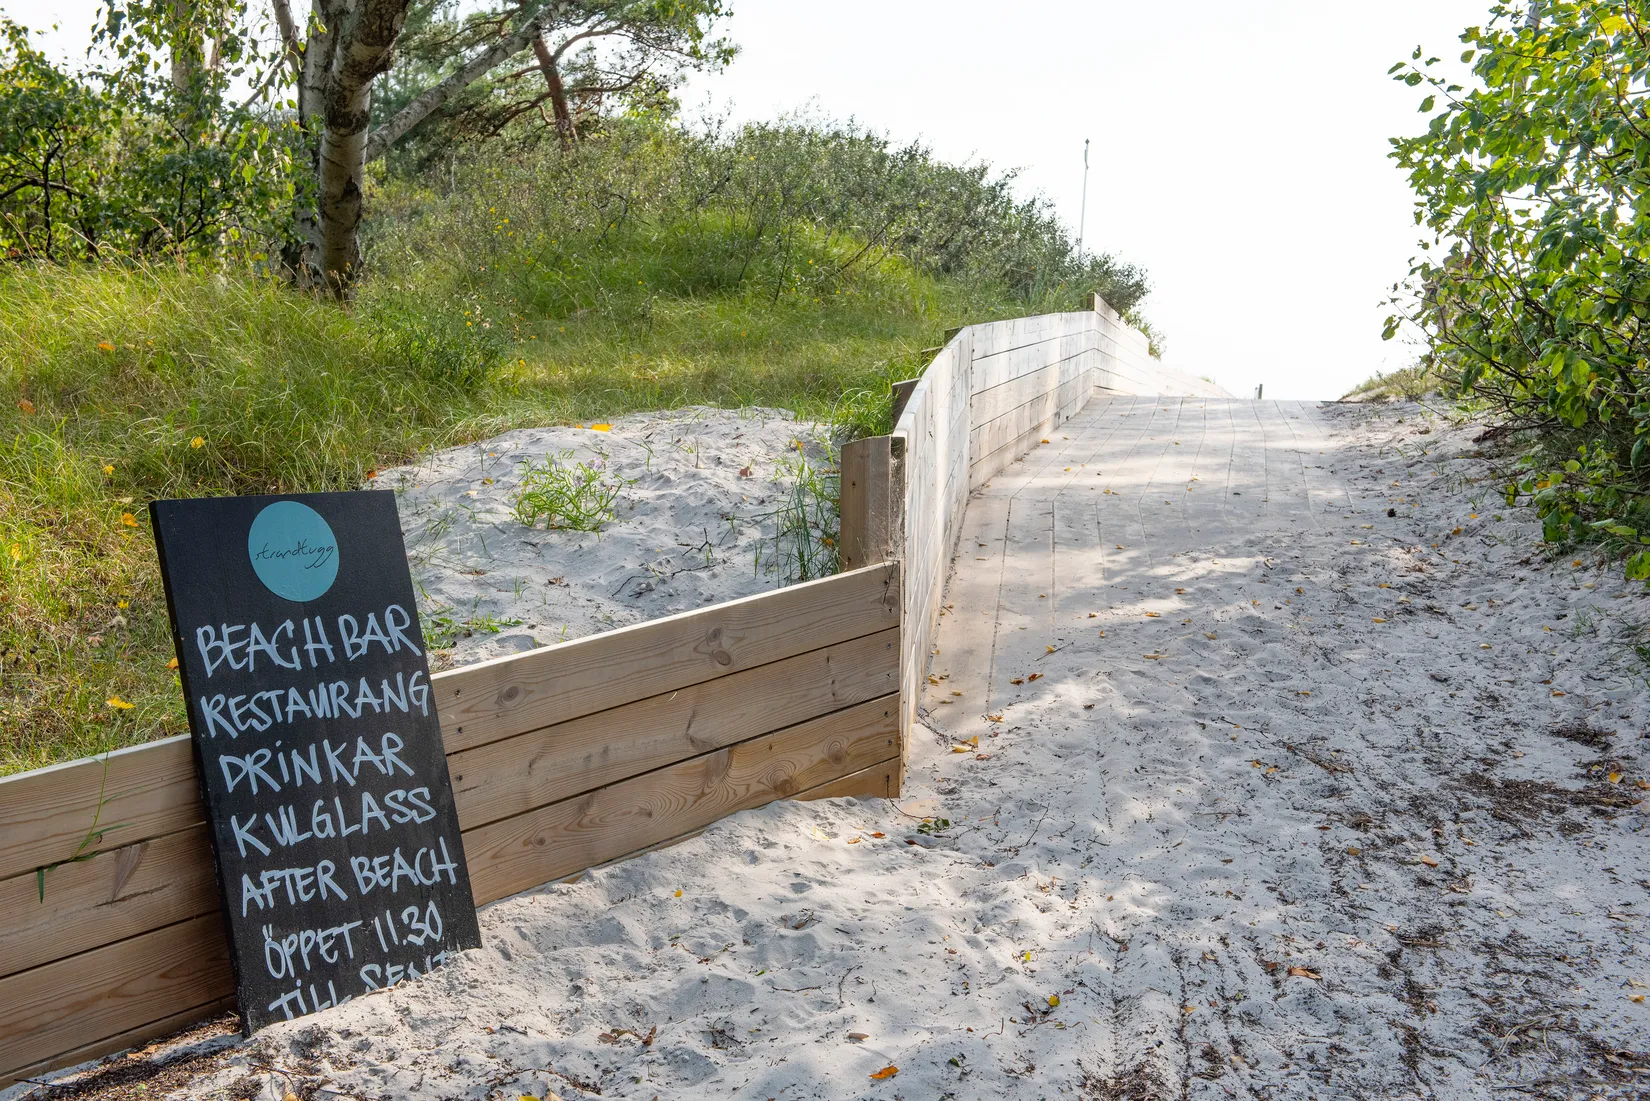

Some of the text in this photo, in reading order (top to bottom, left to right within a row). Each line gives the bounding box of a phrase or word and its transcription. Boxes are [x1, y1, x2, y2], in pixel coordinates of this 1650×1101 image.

[255, 538, 334, 569] strandtugg
[196, 604, 422, 678] BEACH BAR
[201, 670, 429, 739] RESTAURANG
[230, 787, 437, 858] KULGLASS
[242, 836, 458, 917] AFTER BEACH
[262, 900, 443, 979] ÖPPET 11.30
